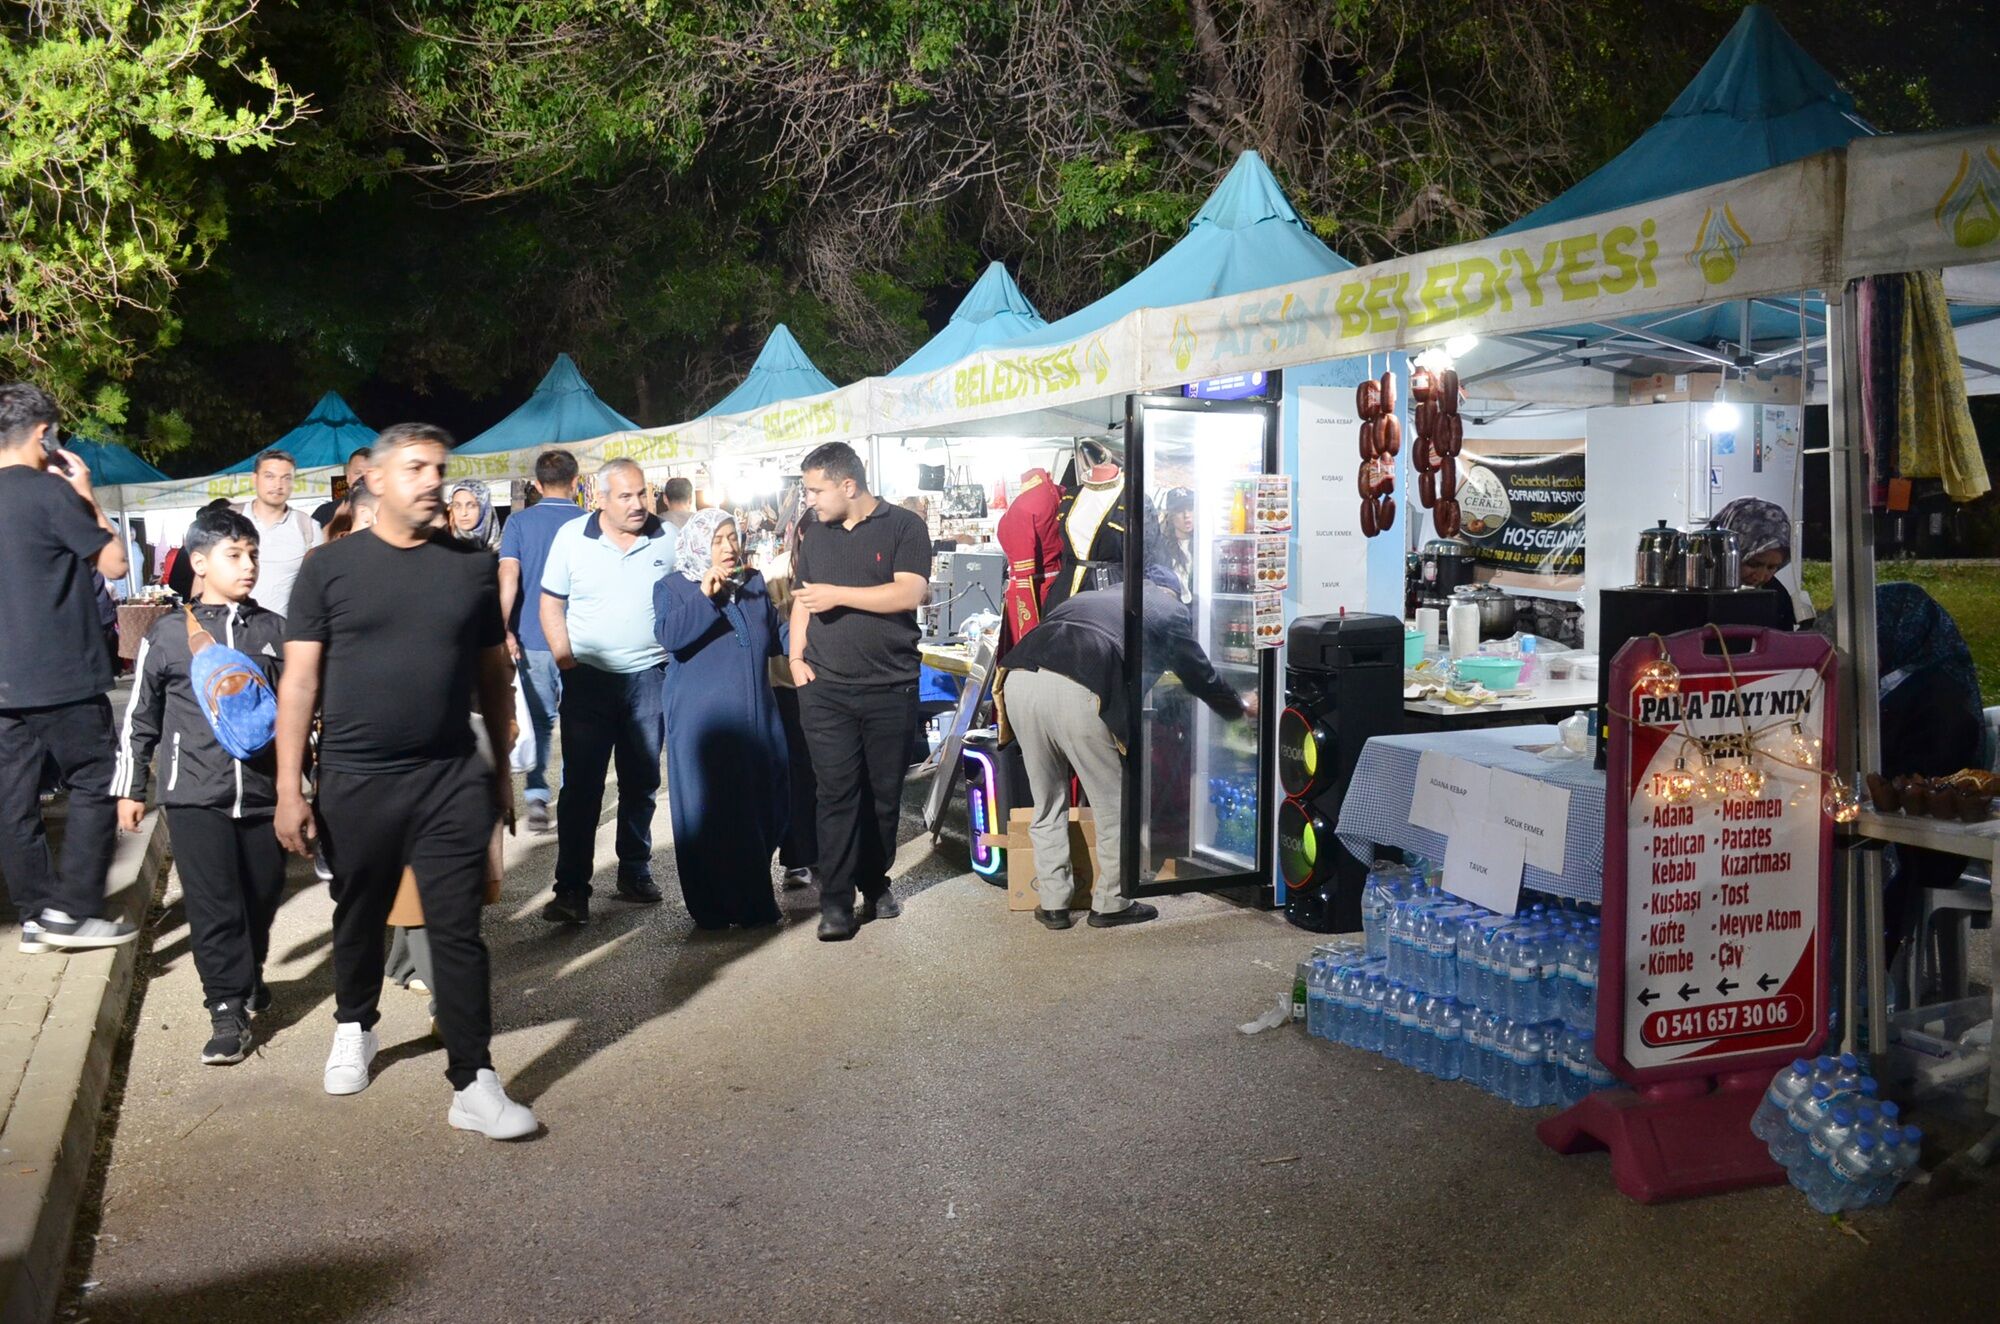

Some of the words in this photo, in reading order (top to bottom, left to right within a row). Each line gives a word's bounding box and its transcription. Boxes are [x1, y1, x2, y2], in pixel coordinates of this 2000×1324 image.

[1336, 217, 1658, 339] BELEDİYESİ
[955, 344, 1081, 409] BELEDİYESİ
[1641, 694, 1703, 723] PALA
[1710, 689, 1812, 719] DAYI'NIN
[1429, 777, 1449, 791] ADANA
[1450, 784, 1468, 796] KEBAP
[1503, 815, 1523, 830] SUCUK
[1523, 823, 1545, 837] EKMEK
[1653, 803, 1694, 828] Adana
[1653, 832, 1705, 858] Patlıcan
[1722, 826, 1772, 850] Patates
[1469, 861, 1488, 876] TAVUK
[1652, 858, 1696, 885] Kebabı
[1721, 852, 1791, 877] Kızartması
[1651, 889, 1701, 920] Kuşbaşı
[1720, 882, 1749, 906] Tost
[1649, 921, 1685, 946] Köfte
[1719, 912, 1763, 938] Meyve
[1766, 909, 1802, 934] Atom
[1648, 949, 1694, 976] Kömbe
[1718, 942, 1744, 971] Çay
[1656, 1016, 1668, 1038] 0
[1671, 1012, 1702, 1037] 541
[1707, 1006, 1738, 1031] 657
[1742, 1004, 1763, 1028] 30
[1766, 1001, 1788, 1025] 06
